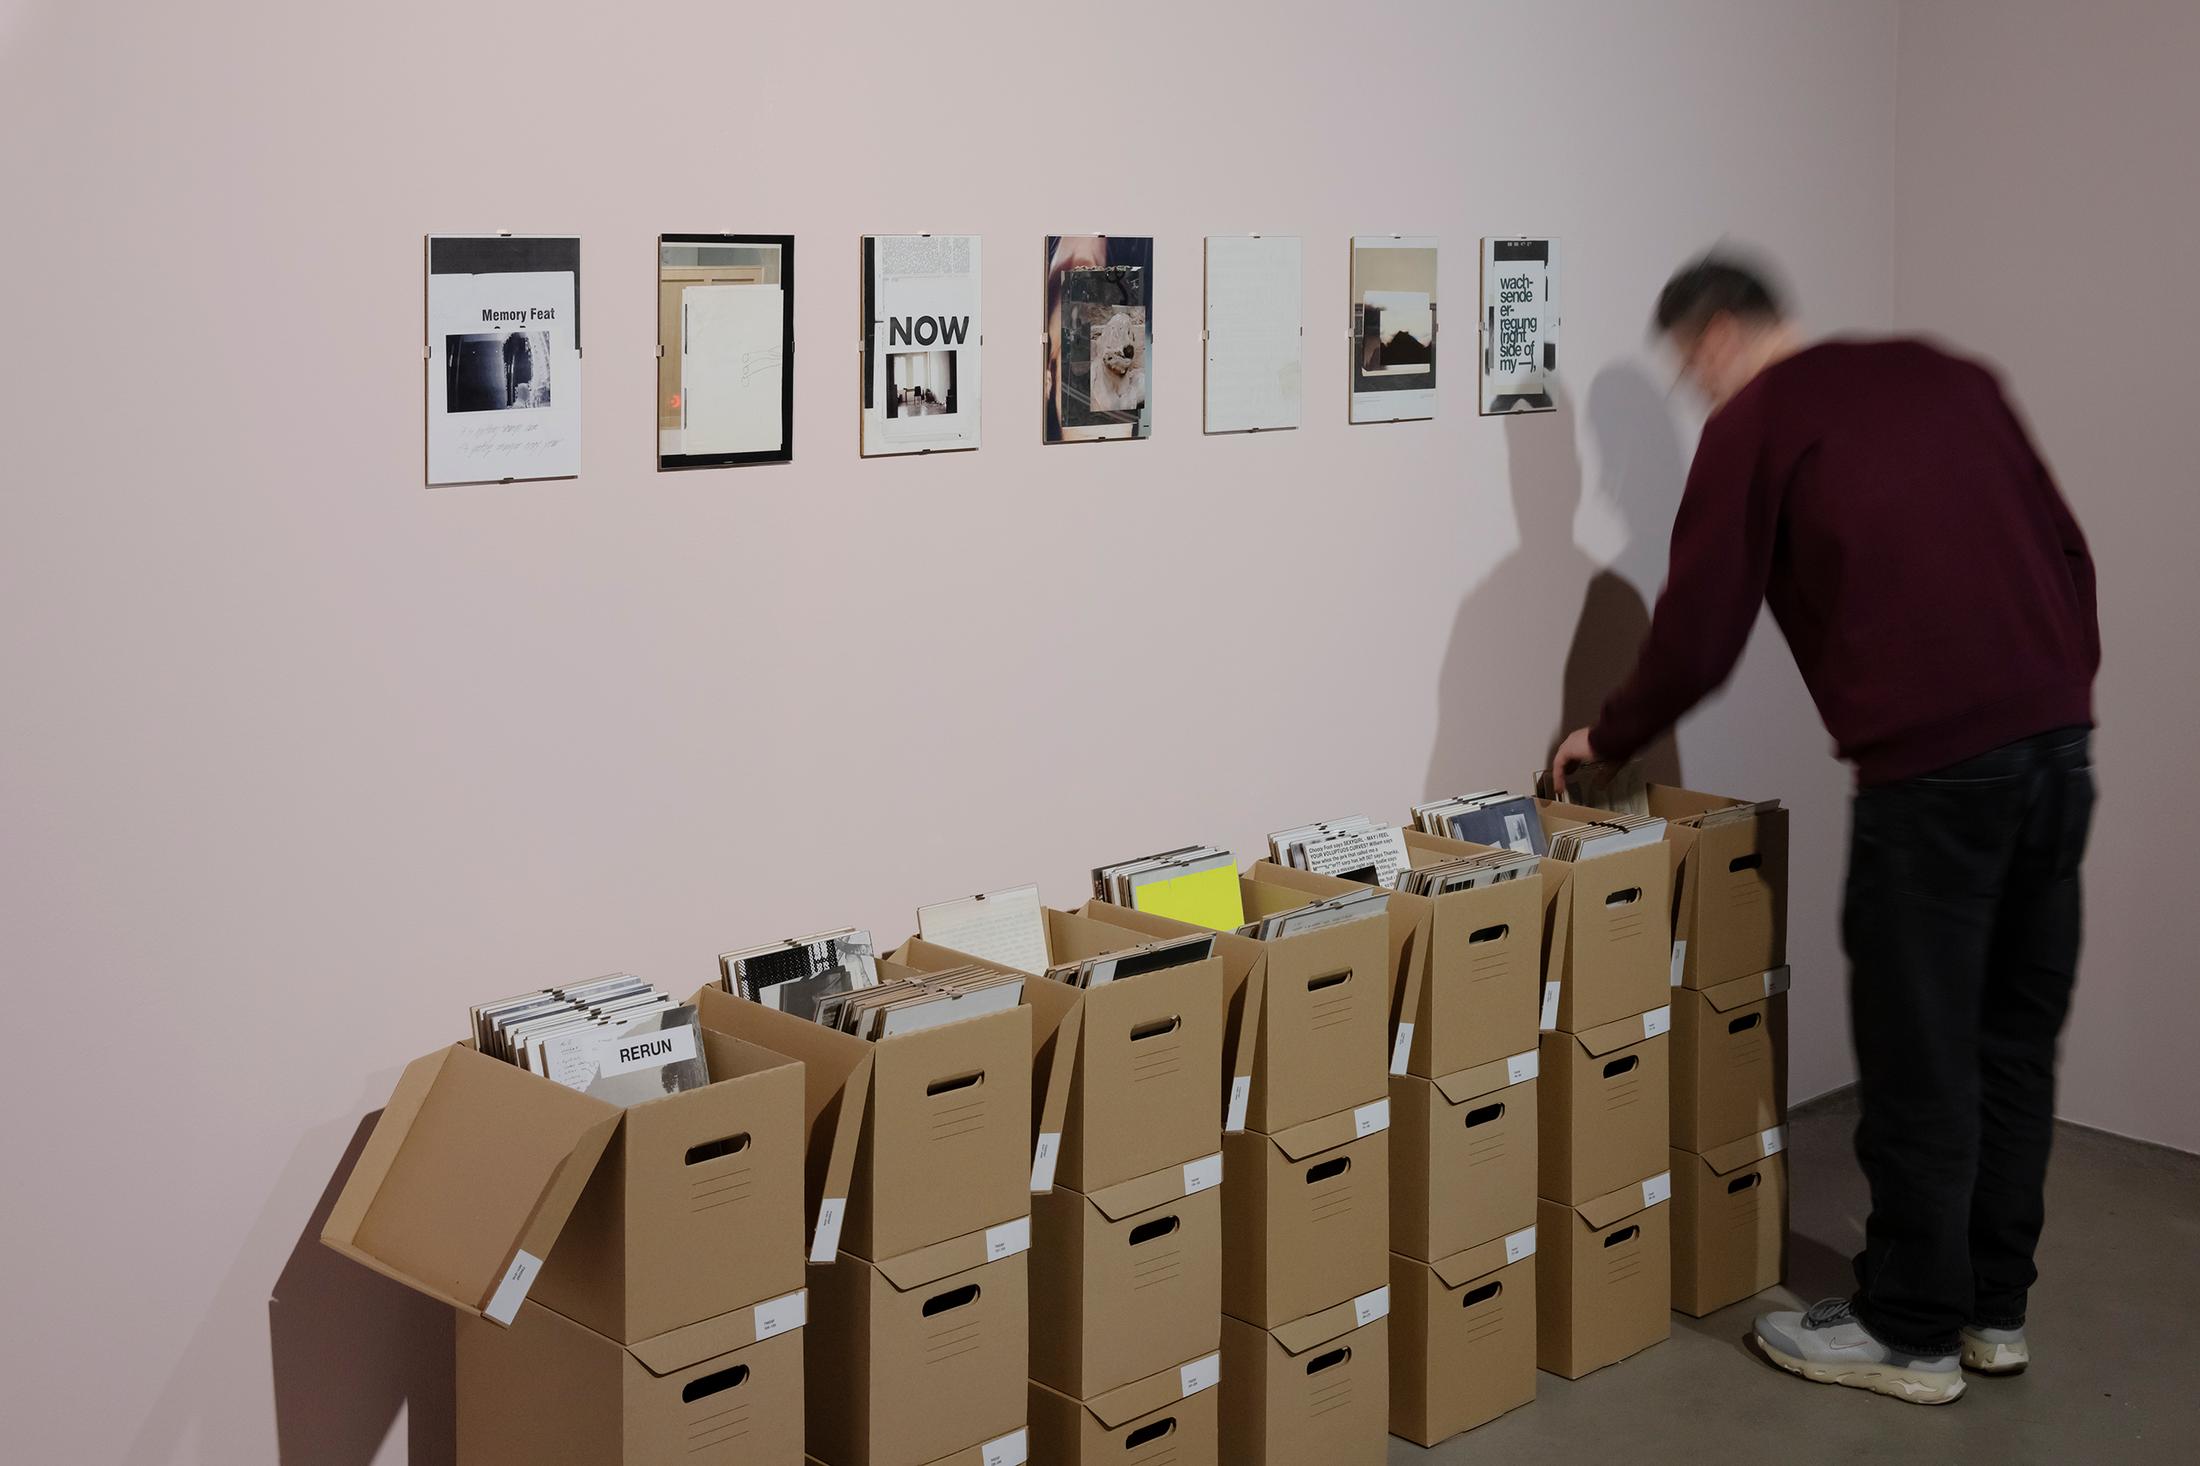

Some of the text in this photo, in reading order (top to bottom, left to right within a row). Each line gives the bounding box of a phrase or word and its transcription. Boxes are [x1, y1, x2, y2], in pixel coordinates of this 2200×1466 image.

[1500, 274, 1533, 290] wach-
[1500, 289, 1532, 303] sende
[482, 307, 555, 323] Memory Feat
[1500, 305, 1514, 317] er-
[889, 315, 970, 346] NOW
[1500, 341, 1535, 357] side of
[1500, 359, 1517, 373] my
[619, 1038, 673, 1064] RERUN
